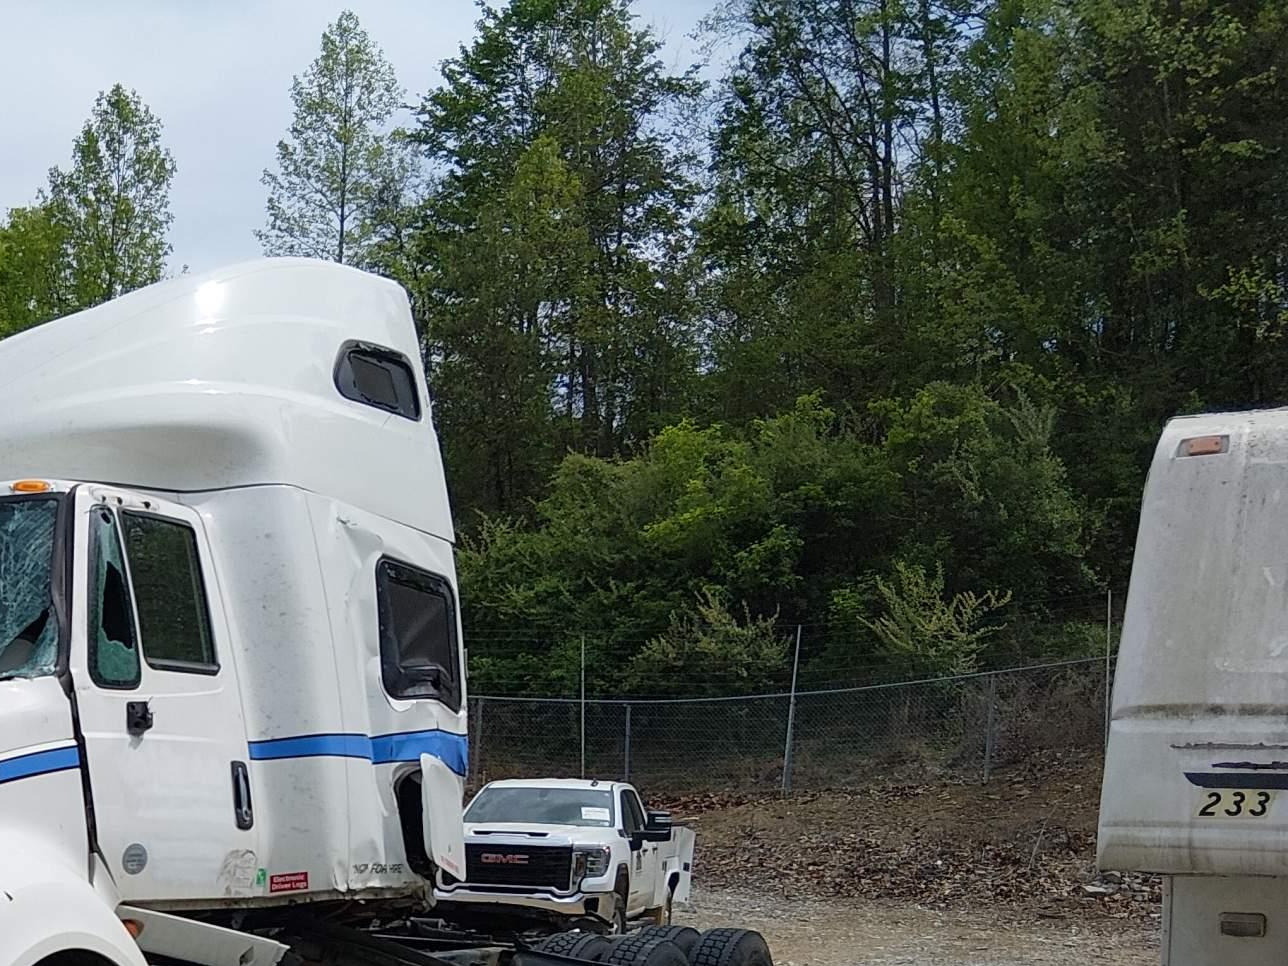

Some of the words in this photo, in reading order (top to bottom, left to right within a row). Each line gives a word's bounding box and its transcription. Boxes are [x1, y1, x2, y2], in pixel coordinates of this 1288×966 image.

[1198, 791, 1271, 817] 233
[481, 853, 529, 864] GMC
[273, 874, 305, 883] Electronic
[271, 883, 291, 891] Driver
[292, 881, 307, 889] Logs
